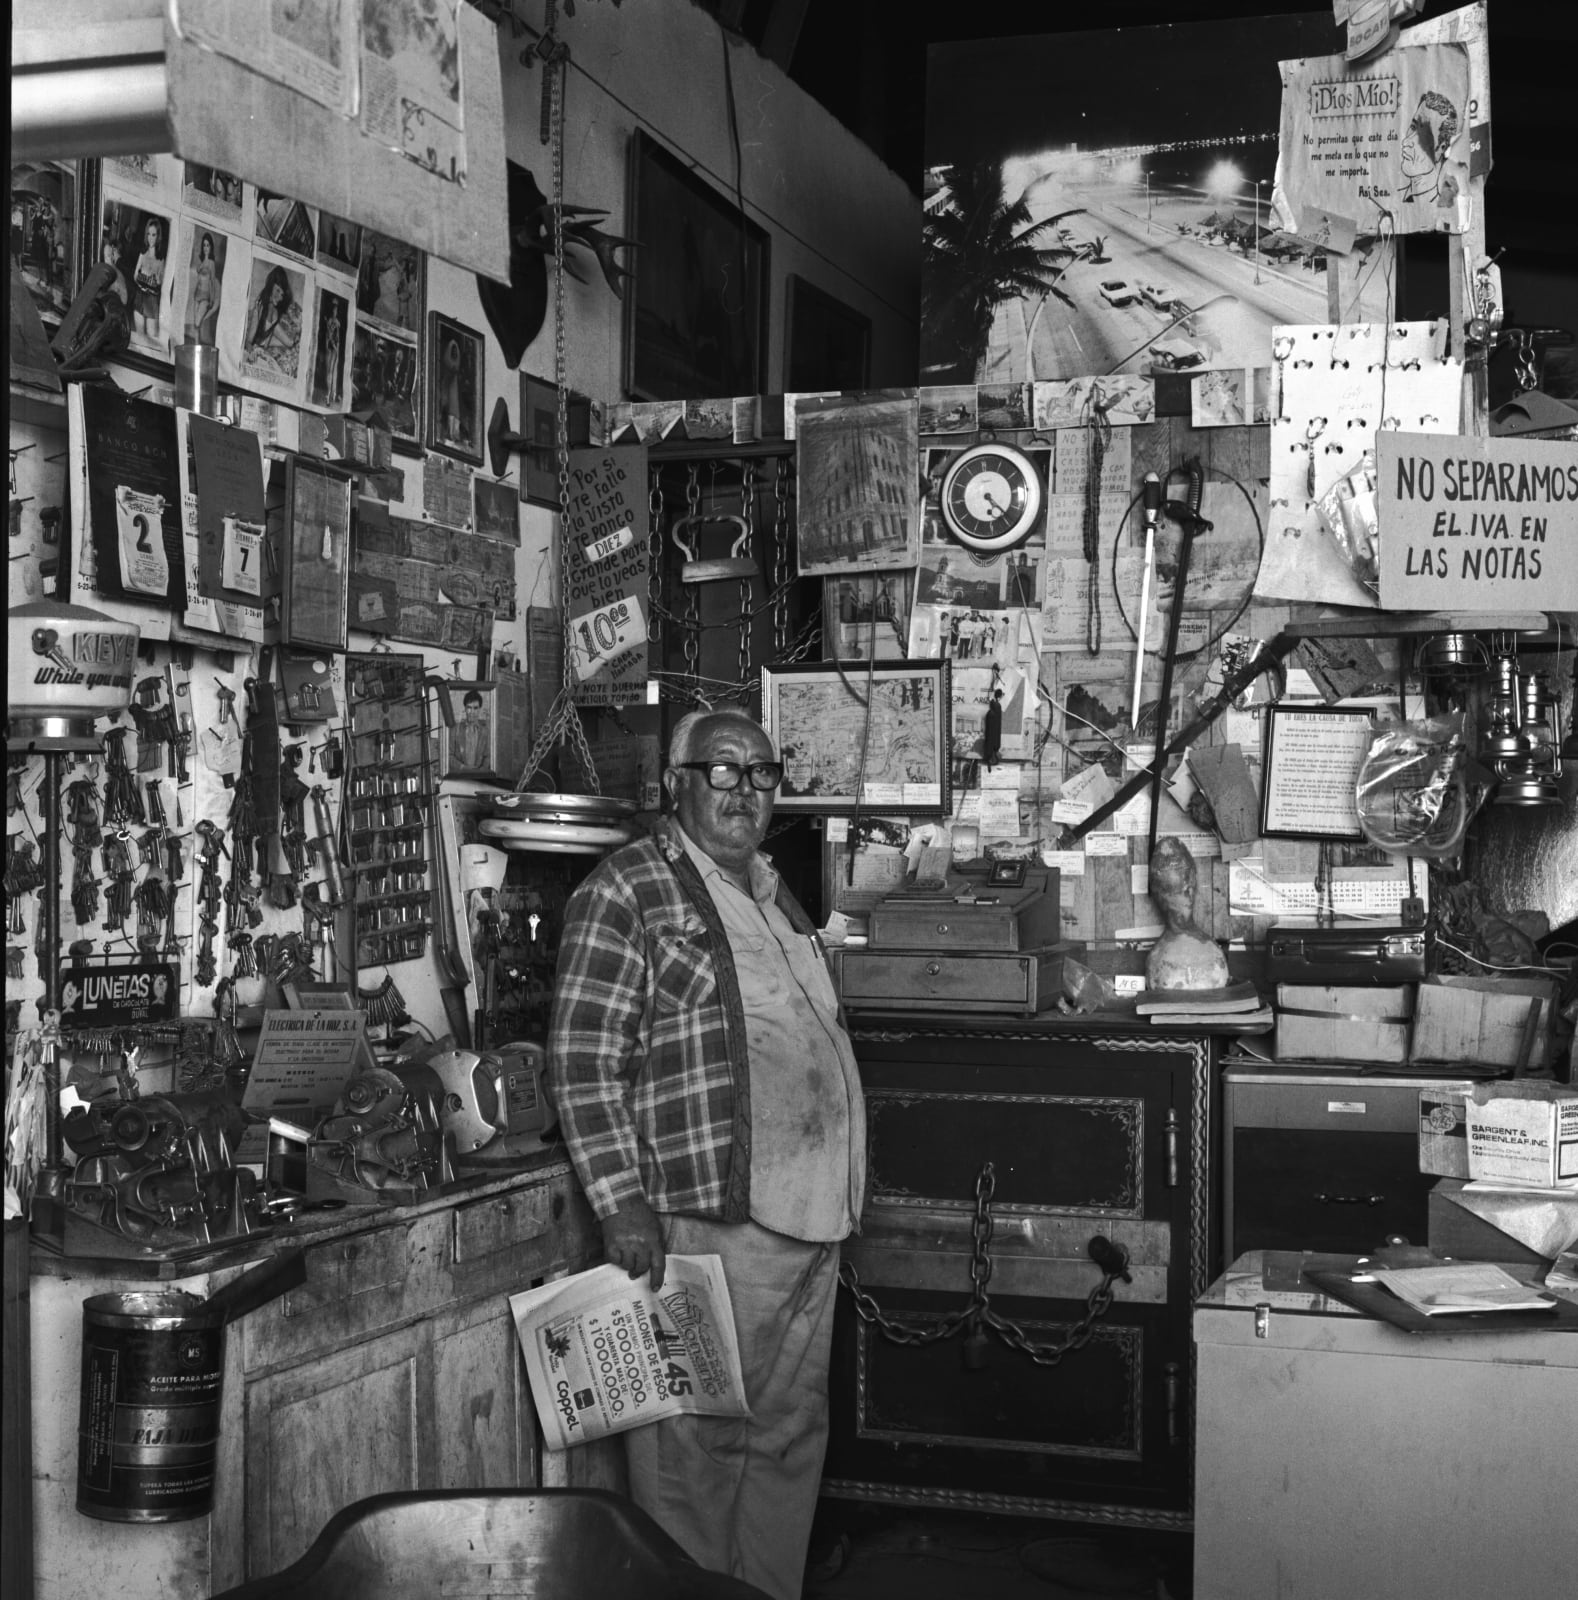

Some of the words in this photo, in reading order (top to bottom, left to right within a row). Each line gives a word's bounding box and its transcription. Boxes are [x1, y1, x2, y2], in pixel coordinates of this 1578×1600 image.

[1303, 134, 1314, 145] No
[1318, 133, 1348, 148] permitas
[1352, 135, 1363, 146] que
[1368, 133, 1382, 142] este
[1311, 153, 1322, 161] me
[1325, 150, 1342, 160] meta
[1355, 147, 1361, 159] lo
[1363, 151, 1377, 162] que
[1339, 165, 1370, 180] importa.
[1373, 185, 1391, 197] Sea.
[1397, 457, 1434, 502] NO
[1443, 458, 1578, 502] SEPARAMOS
[132, 513, 153, 554] 2
[1521, 517, 1548, 542] EN
[594, 533, 622, 559] DIEZ
[240, 547, 250, 572] 7
[1405, 546, 1448, 579] LAS
[1462, 546, 1542, 580] NOTAS
[34, 667, 84, 685] While
[86, 673, 112, 690] you
[1471, 1124, 1517, 1136] SARGENT
[625, 1313, 632, 1324] UN
[628, 1324, 640, 1350] PREMIO
[605, 1332, 620, 1366] CUARENTA
[615, 1367, 624, 1383] MAS
[631, 1299, 656, 1352] MILLONES
[647, 1352, 659, 1370] DE
[653, 1370, 670, 1401] PESOS
[636, 1350, 649, 1381] PRINCIPAL
[150, 1375, 178, 1384] ACEITE
[180, 1375, 201, 1383] PARA
[664, 1361, 694, 1397] 45
[556, 1380, 580, 1432] Coppel
